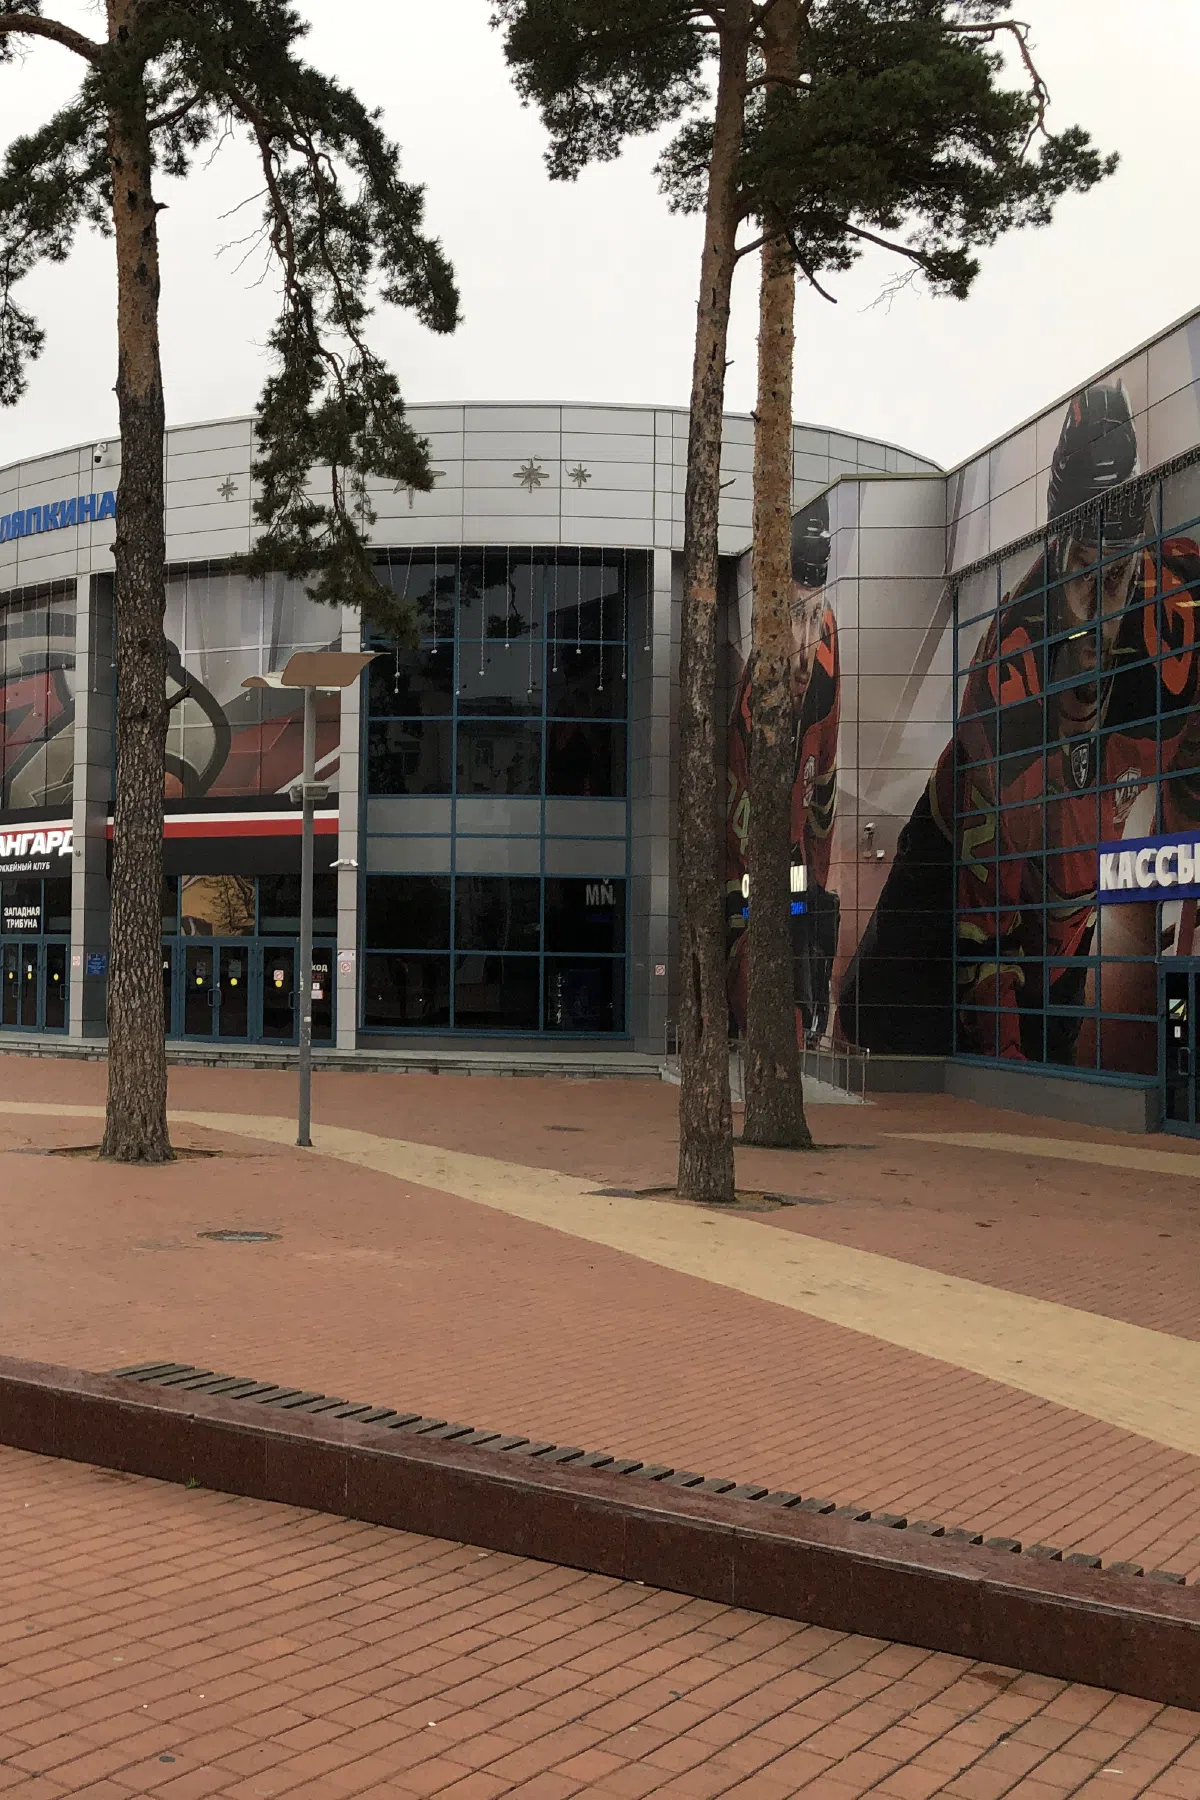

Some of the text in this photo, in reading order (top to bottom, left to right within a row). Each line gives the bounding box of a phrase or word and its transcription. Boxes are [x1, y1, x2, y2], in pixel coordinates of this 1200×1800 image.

[33, 861, 50, 871] КЛУБ
[3, 906, 41, 917] ЗАПАДНАЯ
[6, 918, 38, 929] ТРИБУНА
[311, 963, 328, 972] ХОД
